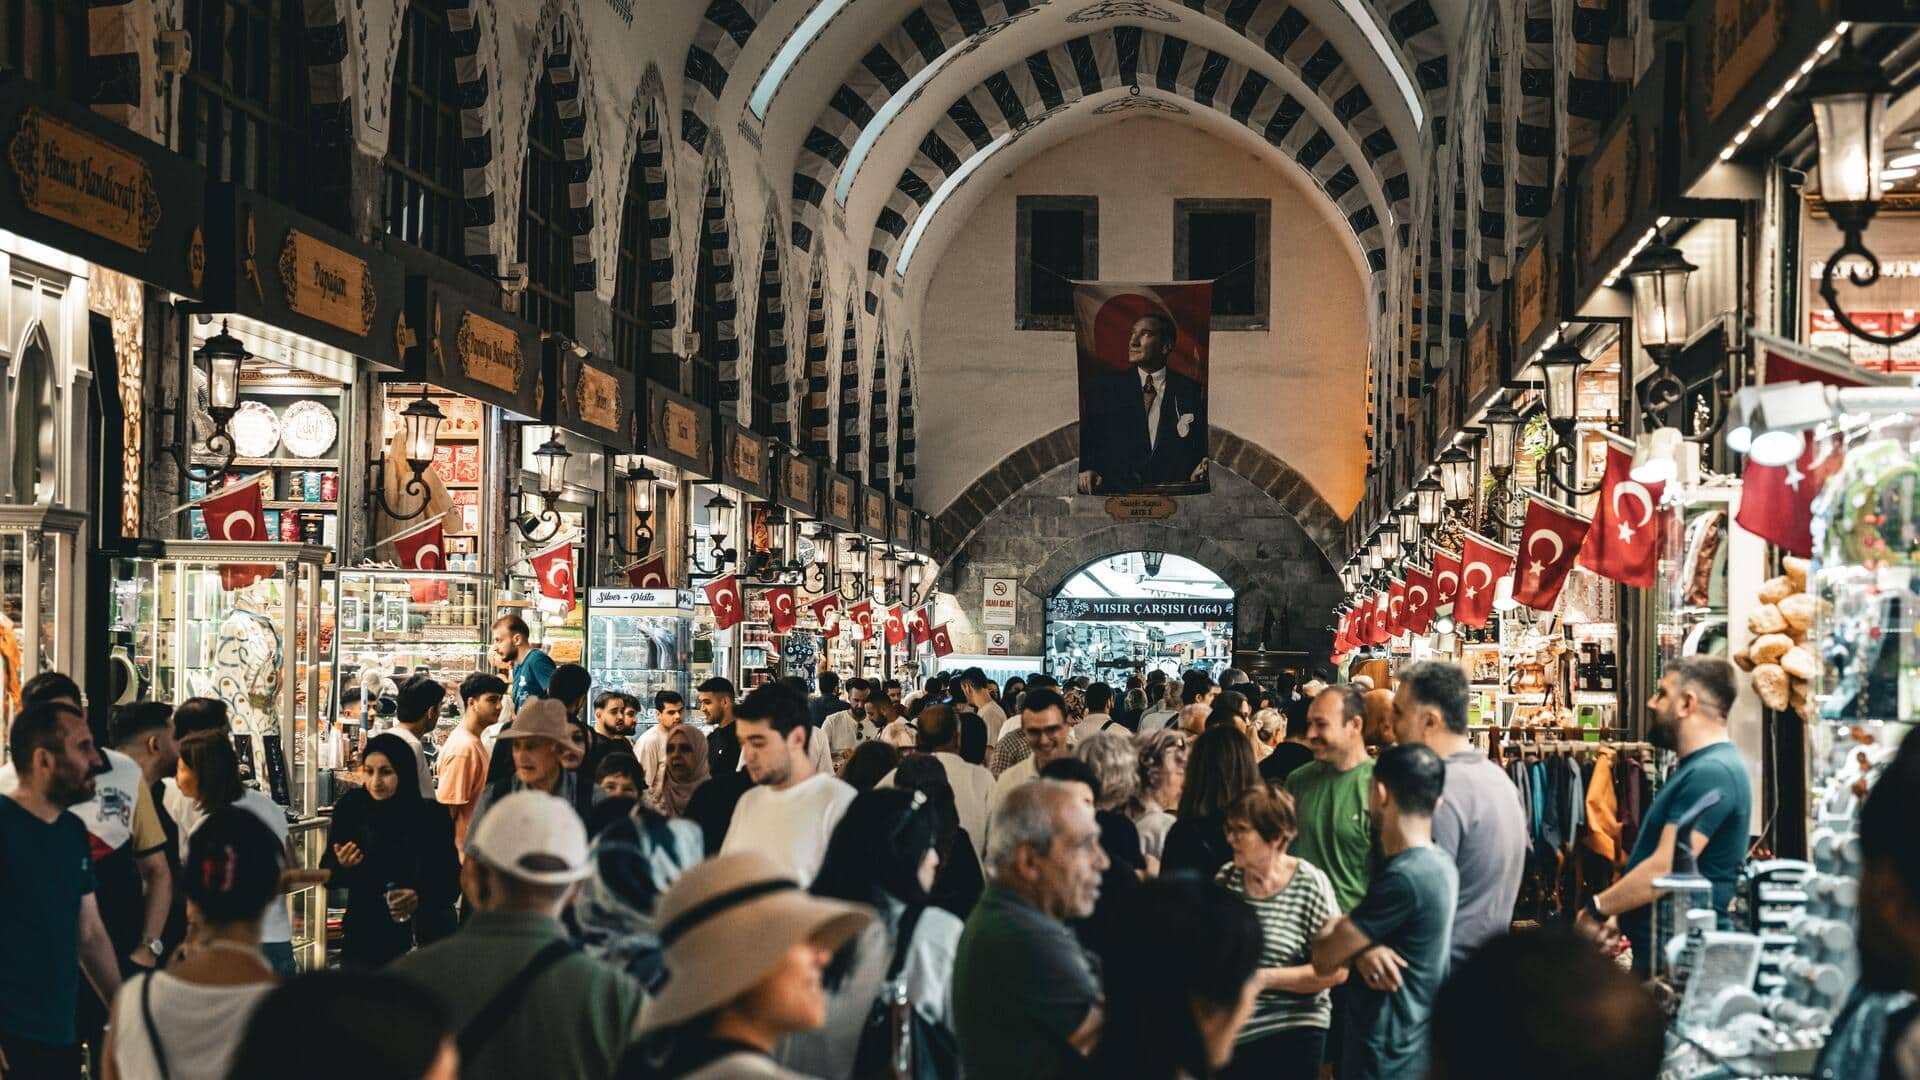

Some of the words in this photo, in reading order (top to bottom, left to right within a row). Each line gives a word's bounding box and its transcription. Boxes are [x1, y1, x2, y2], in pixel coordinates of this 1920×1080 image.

[79, 157, 137, 224] Handicraft
[596, 592, 621, 604] Silver
[1093, 603, 1131, 614] MISIR
[1133, 603, 1185, 616] ÇARŞISI
[1187, 603, 1223, 617] (1664)
